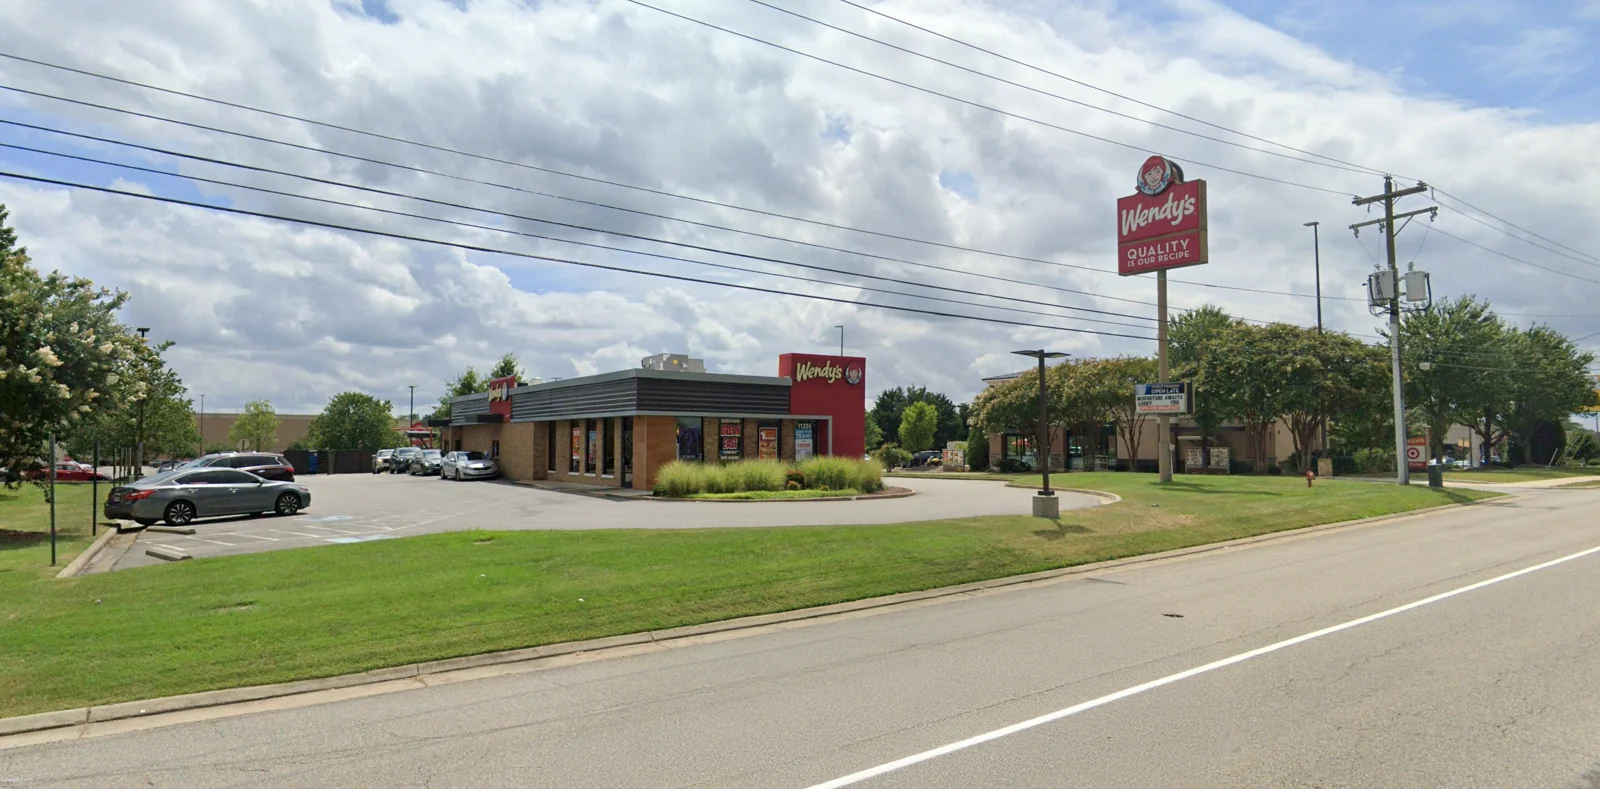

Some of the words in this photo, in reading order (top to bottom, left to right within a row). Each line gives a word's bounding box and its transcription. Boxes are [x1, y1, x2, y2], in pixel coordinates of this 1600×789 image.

[1121, 192, 1195, 236] Wendy's
[1127, 238, 1190, 259] QUALITY
[1137, 257, 1155, 266] OUR
[1158, 250, 1189, 262] RECIPE
[796, 360, 842, 384] Wendy's
[720, 424, 741, 437] BREAK
[723, 437, 738, 450] FAST
